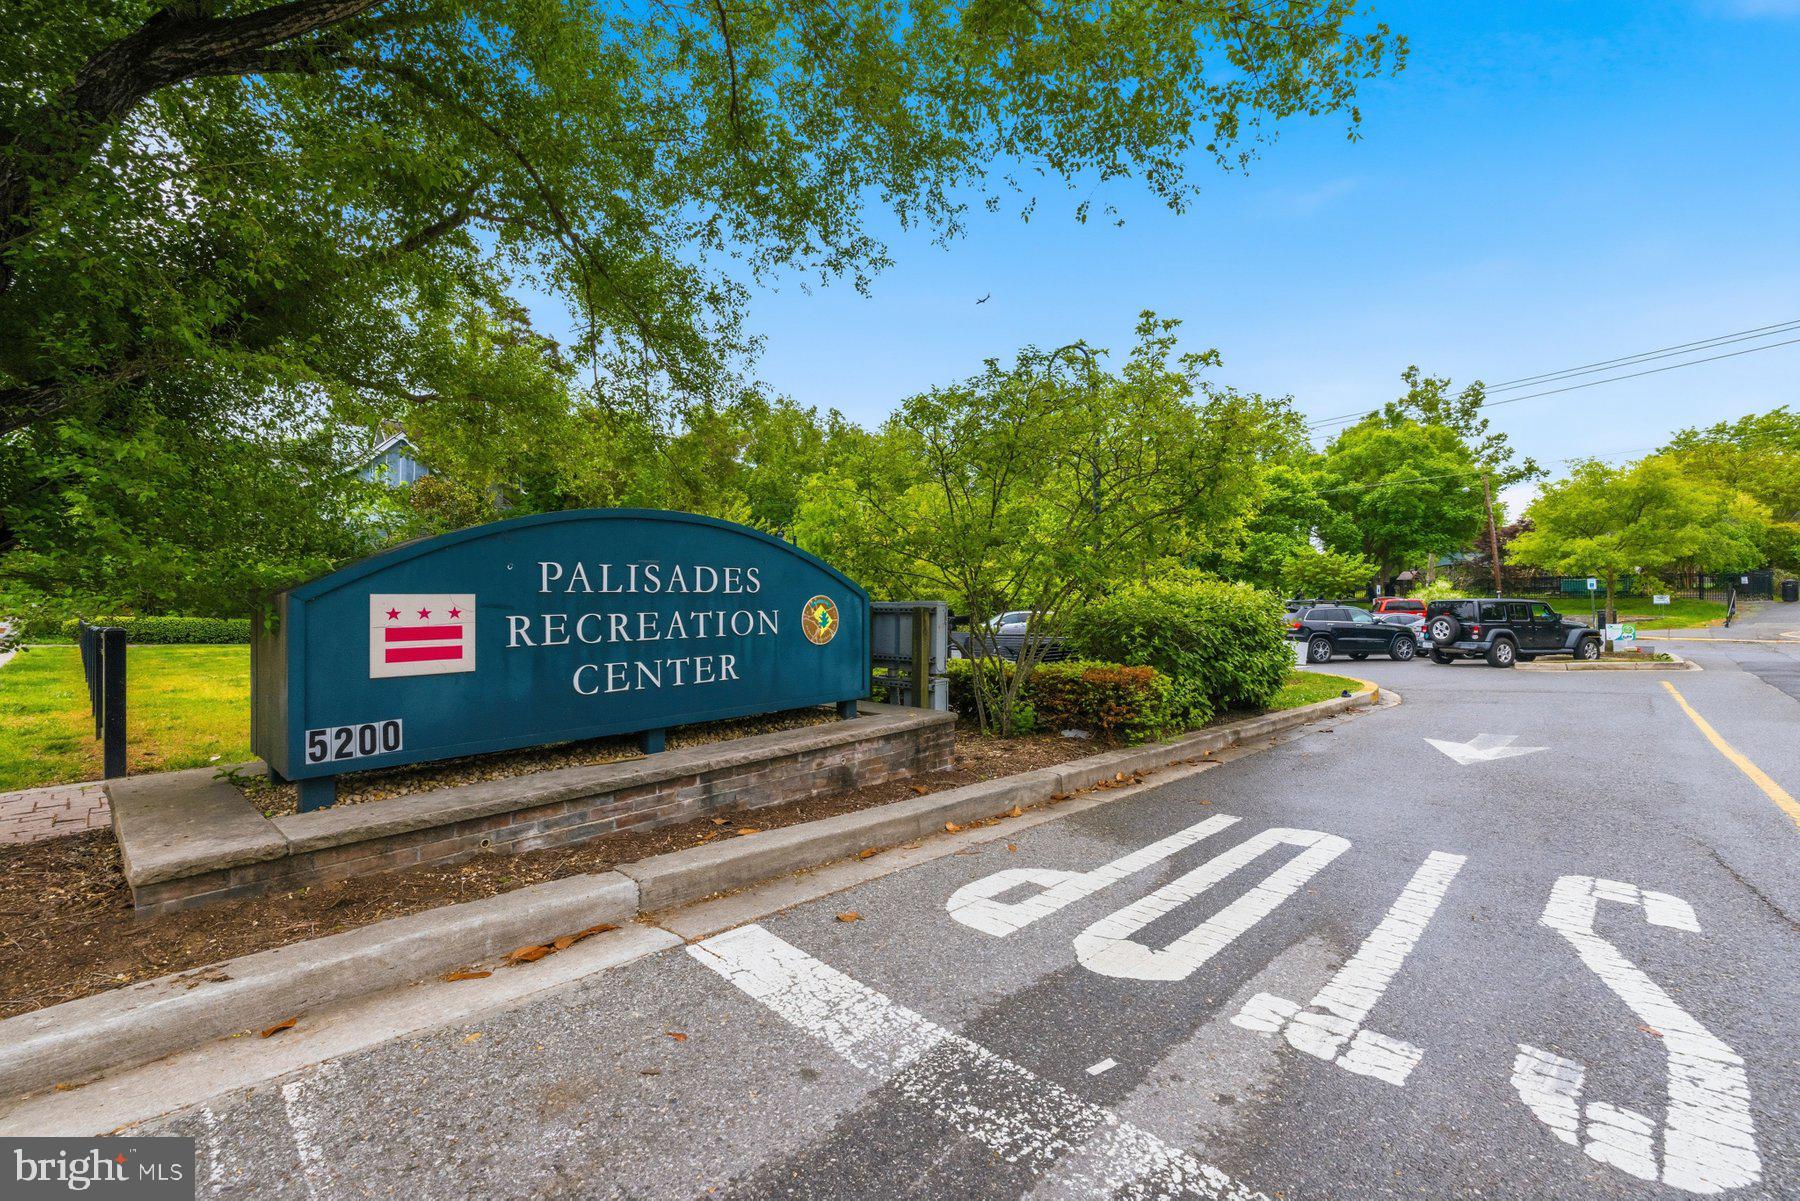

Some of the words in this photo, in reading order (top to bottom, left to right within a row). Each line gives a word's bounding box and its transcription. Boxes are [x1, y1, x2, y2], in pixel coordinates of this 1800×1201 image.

[538, 561, 762, 595] PALISADES
[506, 608, 780, 648] RECREATION
[572, 654, 740, 696] CENTER
[308, 719, 402, 763] 5200
[946, 813, 1762, 1194] STOP
